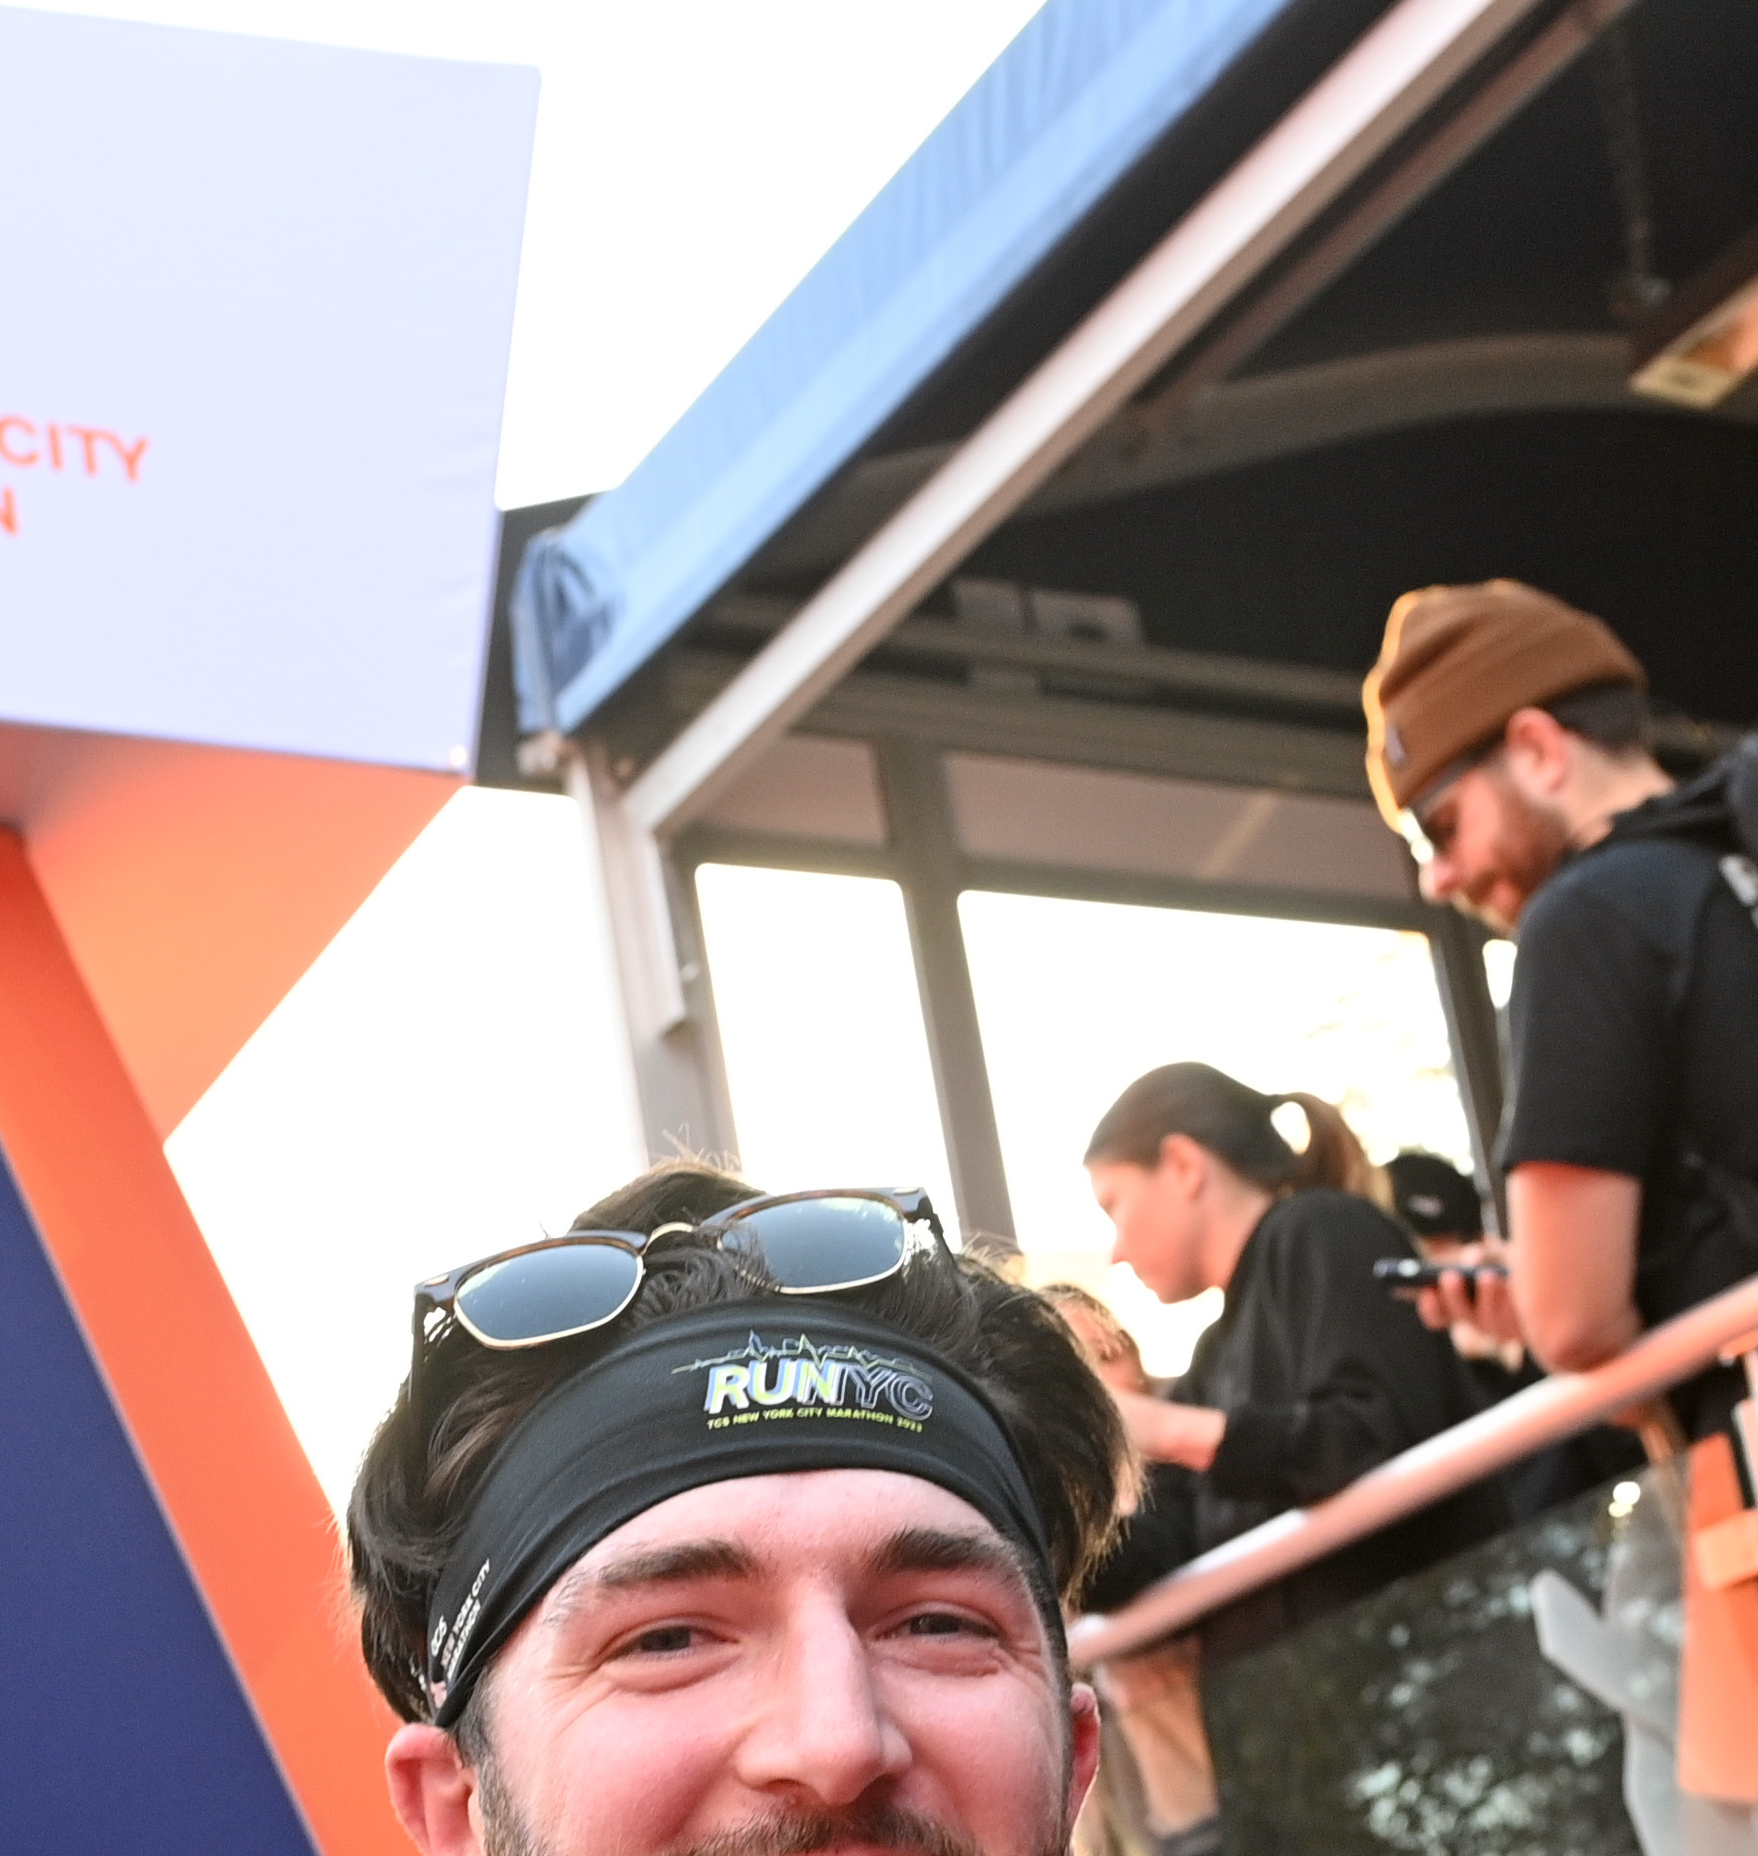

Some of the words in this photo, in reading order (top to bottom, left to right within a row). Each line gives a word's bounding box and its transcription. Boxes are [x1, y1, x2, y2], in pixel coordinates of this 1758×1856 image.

[732, 1410, 760, 1425] NEW
[762, 1407, 795, 1421] YORK
[796, 1406, 823, 1419] CITY
[826, 1407, 894, 1426] MARATHON
